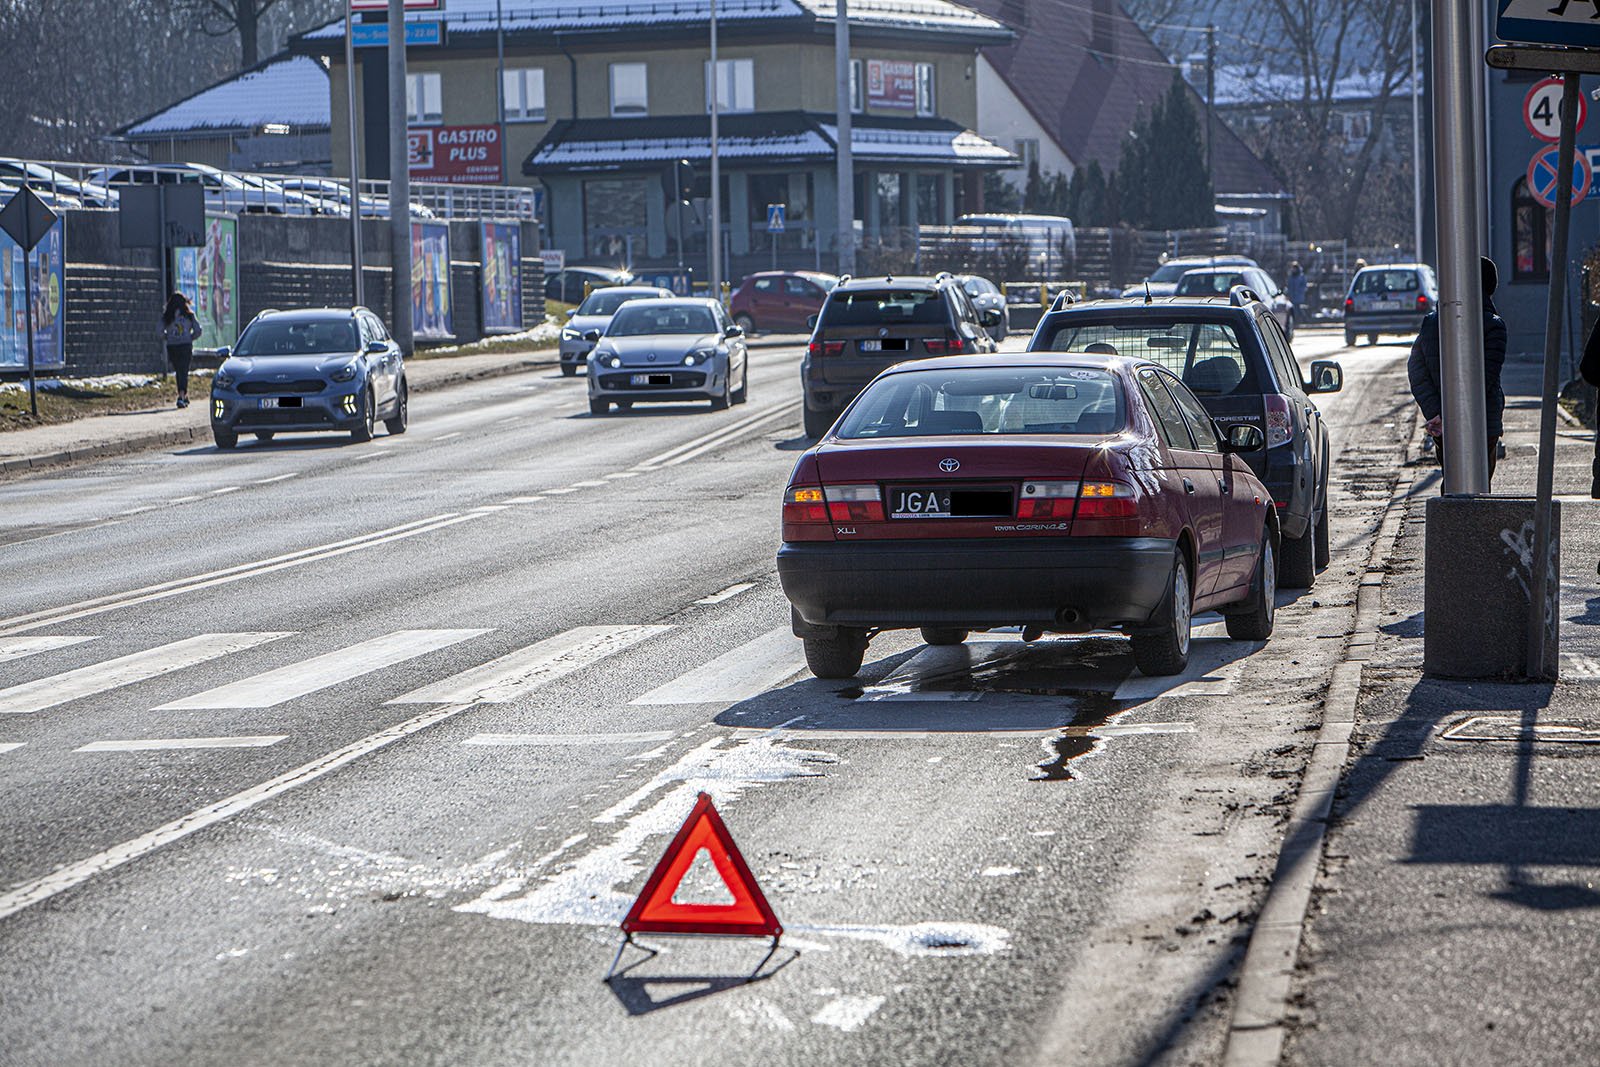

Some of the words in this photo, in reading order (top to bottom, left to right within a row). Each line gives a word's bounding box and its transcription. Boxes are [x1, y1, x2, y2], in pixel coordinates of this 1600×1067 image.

[438, 129, 497, 144] GASTRO
[450, 147, 487, 161] PLUS
[895, 492, 940, 513] JGA
